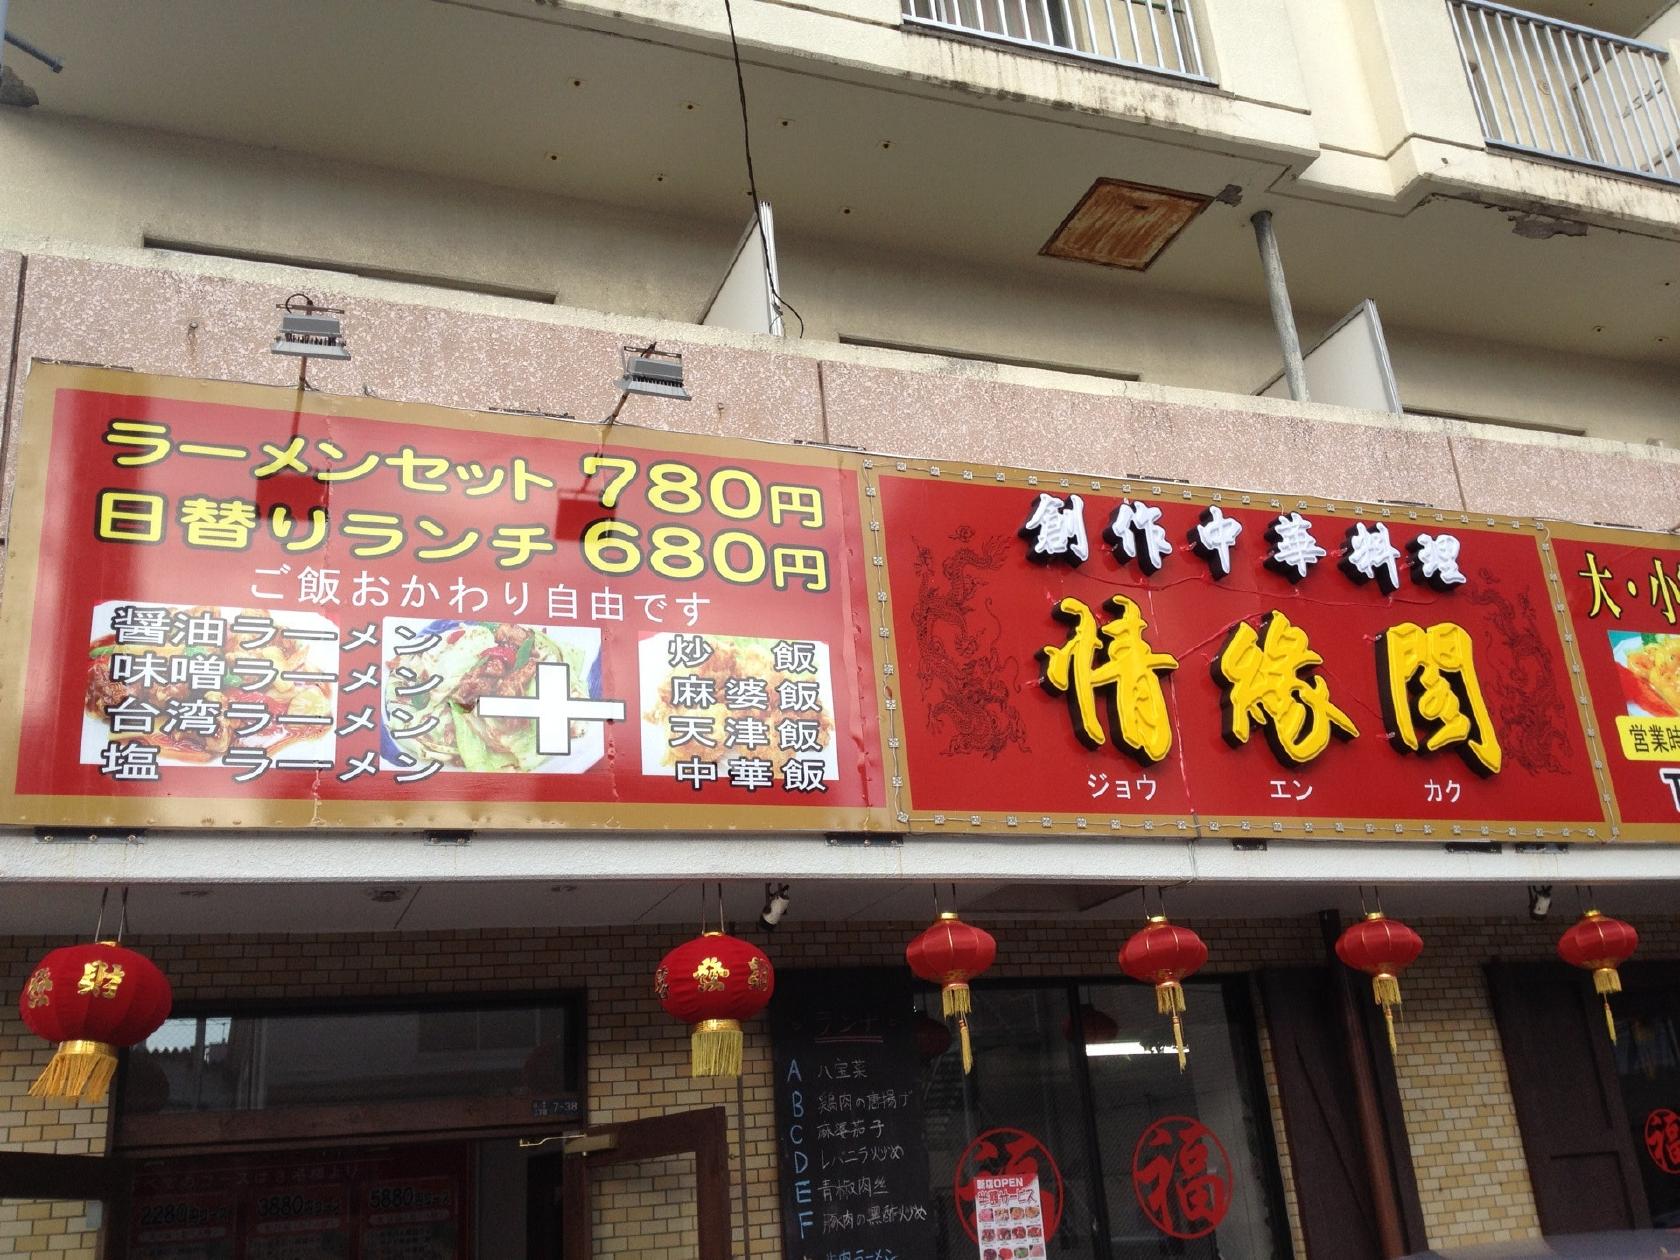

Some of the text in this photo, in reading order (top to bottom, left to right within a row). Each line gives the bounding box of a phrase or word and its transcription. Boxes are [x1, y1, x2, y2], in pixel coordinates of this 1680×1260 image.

[104, 421, 823, 528] ラーメンセット 780円
[97, 490, 827, 591] 日替りランチ 680円
[1020, 493, 1467, 592] 創作中華料理
[250, 564, 711, 626] ご飯おかわり自由です
[112, 606, 443, 656] 醤油ラーメン
[110, 652, 444, 697] 味噌ラーメン
[670, 675, 822, 712] 麻婆飯
[105, 695, 440, 740] 台湾ラーメン
[668, 715, 823, 752] 天津飯
[675, 756, 827, 791] 中華飯
[1086, 773, 1461, 801] ジョウ エン カク
[786, 1059, 802, 1083] A
[791, 1090, 804, 1118] B
[790, 1125, 803, 1145] C
[794, 1151, 808, 1174] D
[1134, 1125, 1226, 1235] 福
[795, 1180, 812, 1204] E
[798, 1211, 814, 1240] F
